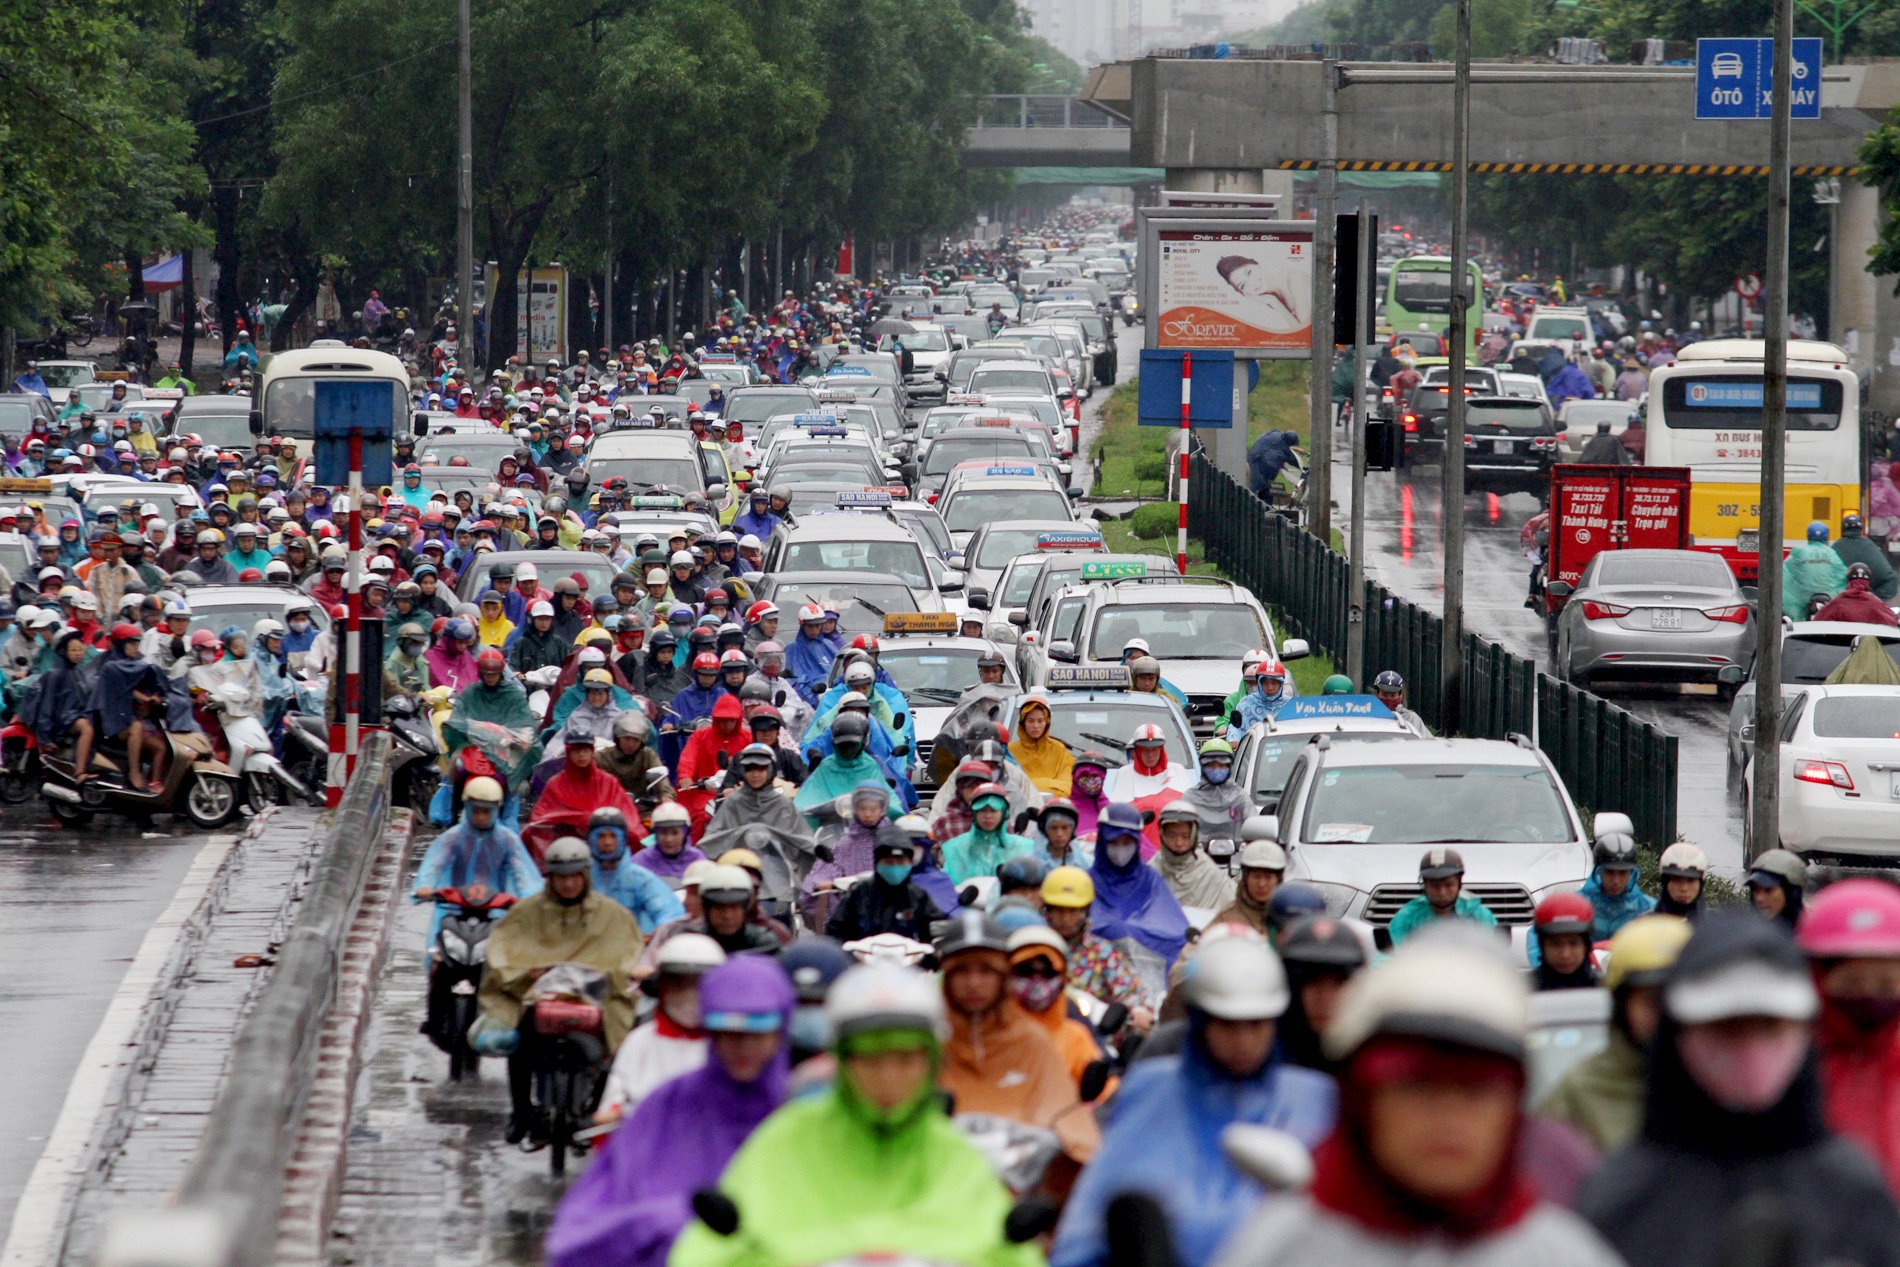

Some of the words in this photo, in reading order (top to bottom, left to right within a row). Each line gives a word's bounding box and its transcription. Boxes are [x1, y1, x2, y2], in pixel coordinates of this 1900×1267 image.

[1711, 87, 1743, 105] ÔTÔ
[1164, 314, 1235, 336] FOREVER
[841, 493, 855, 501] SAO
[1570, 503, 1588, 514] Taxi
[1717, 504, 1738, 516] 30Z
[1634, 518, 1652, 530] Trọn
[1653, 518, 1668, 530] gói
[1104, 567, 1142, 575] TAXI
[1052, 669, 1073, 680] SAO
